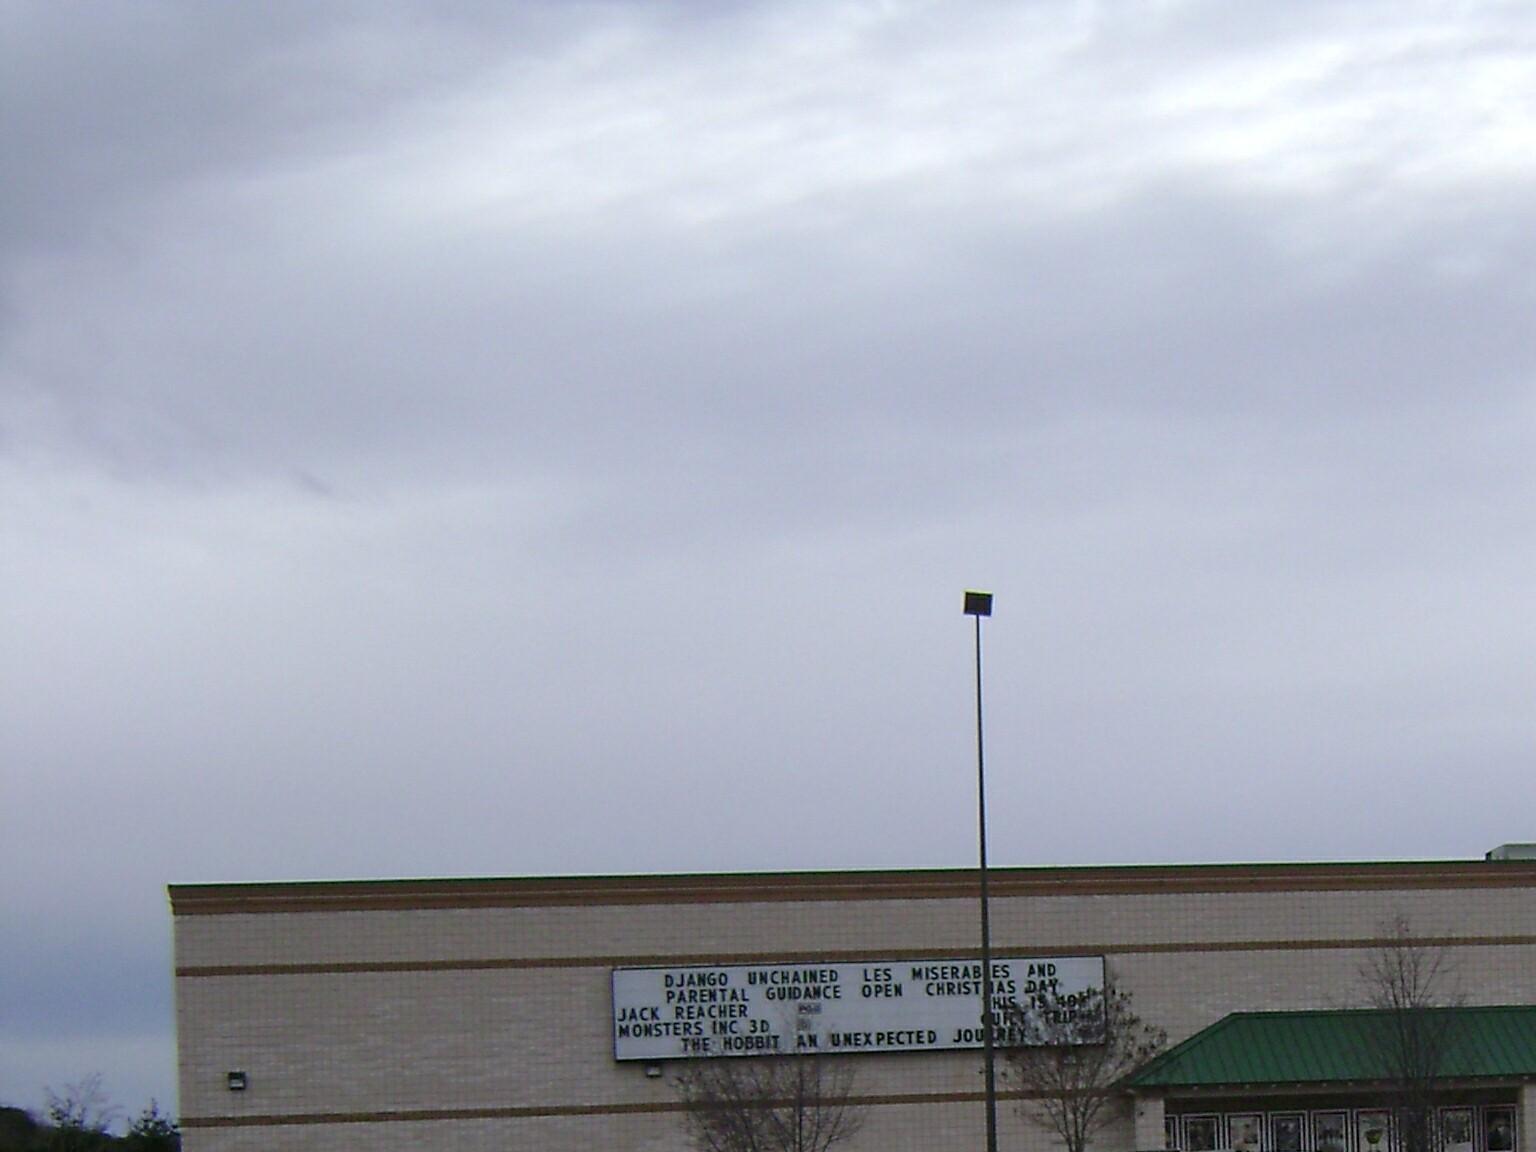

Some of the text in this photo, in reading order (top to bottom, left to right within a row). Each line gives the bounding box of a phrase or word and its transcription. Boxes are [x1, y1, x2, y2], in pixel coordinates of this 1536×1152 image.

[664, 963, 1057, 988] DJANGO UNCHAINED LES MISERABES AND
[666, 988, 750, 1004] PARENTAL
[765, 985, 842, 1001] GUIDANCE
[861, 983, 903, 998] OPEN
[1024, 978, 1059, 994] DAY
[617, 1005, 749, 1022] JACK REACHER
[983, 995, 1017, 1010] HIS
[618, 1019, 771, 1038] MONSTERS INC 3D
[681, 1025, 1027, 1052] THE HOBBIT AN UNEXPECTED JOUNEY
